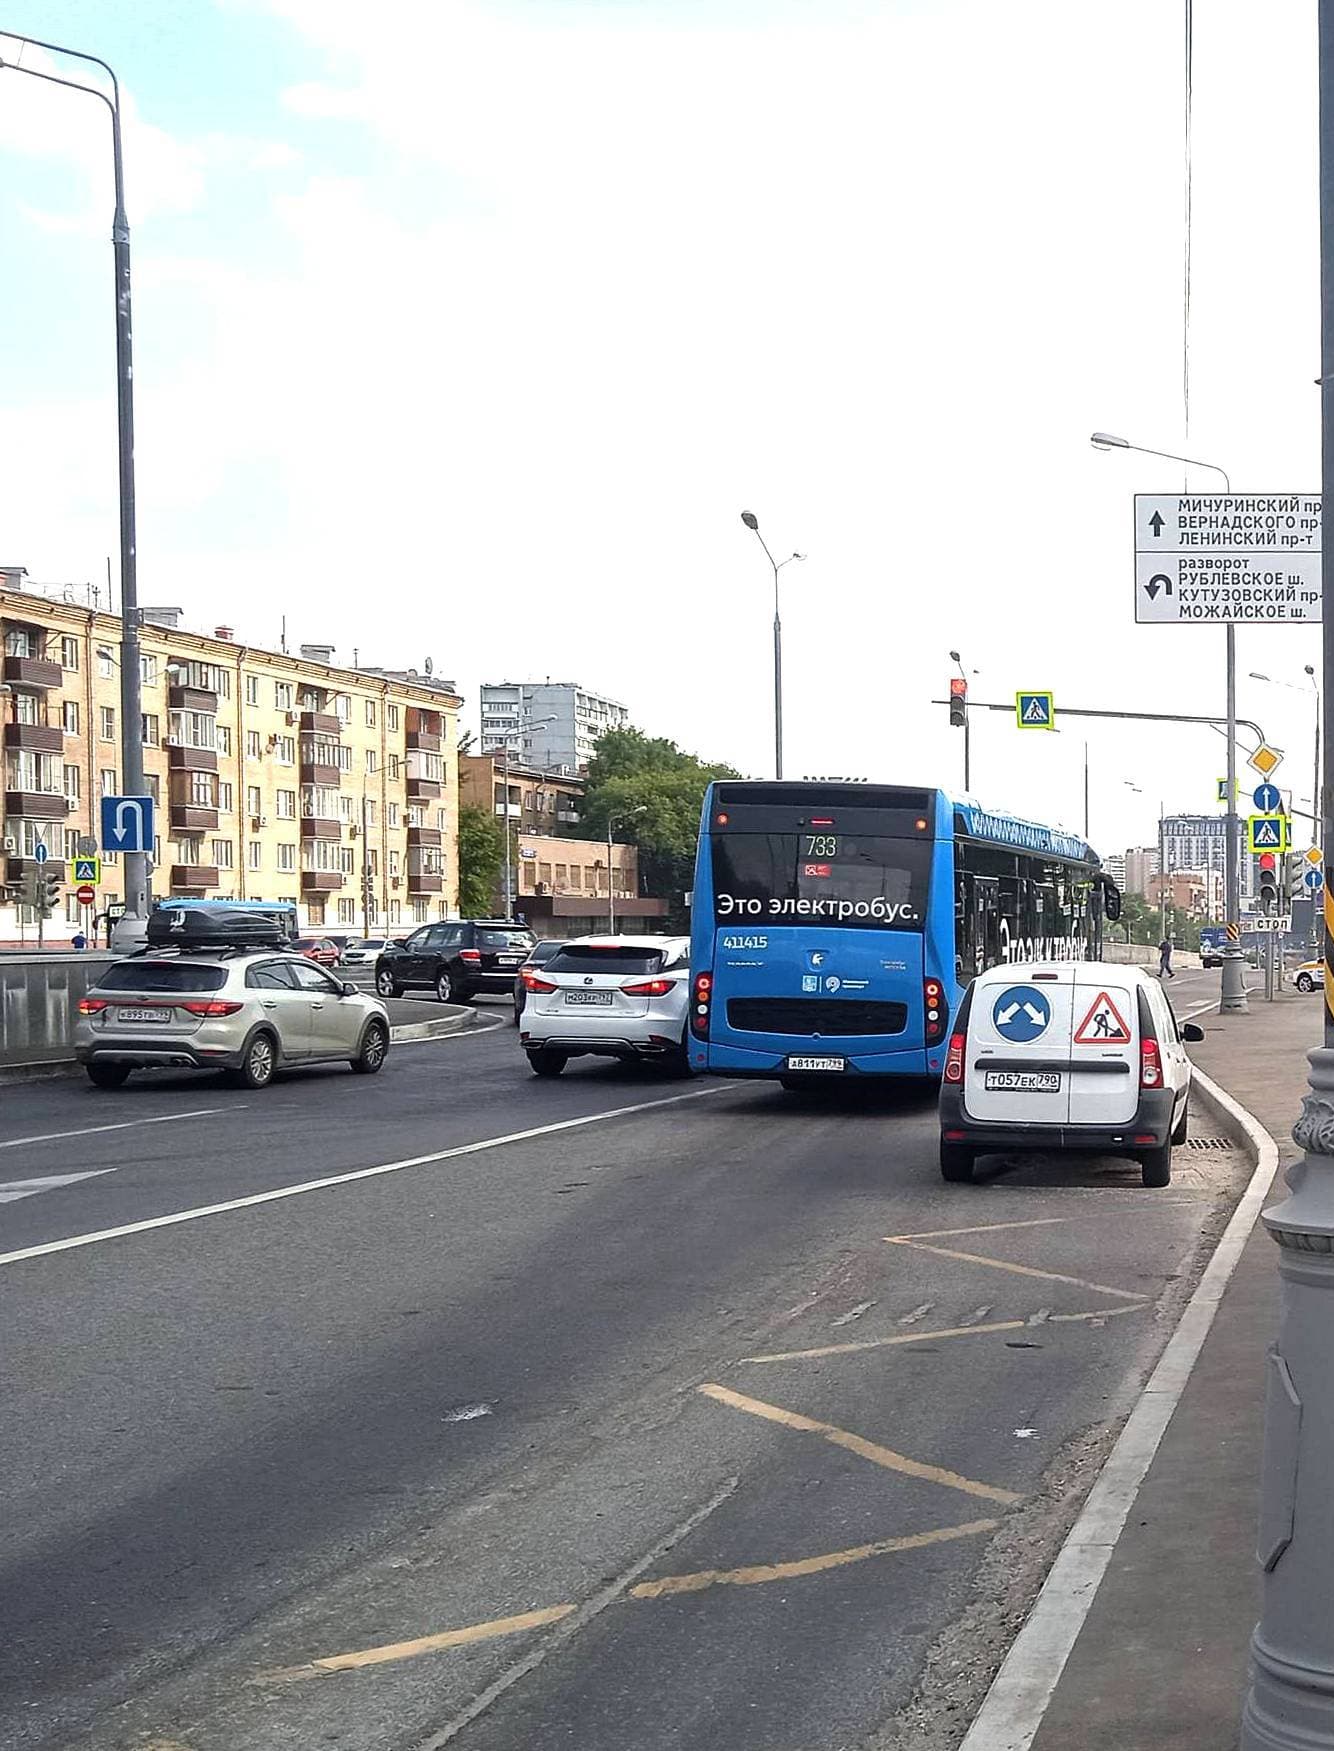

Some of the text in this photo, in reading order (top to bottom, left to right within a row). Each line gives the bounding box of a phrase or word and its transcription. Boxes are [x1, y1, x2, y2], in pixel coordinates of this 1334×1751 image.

[1178, 496, 1322, 515] МИЧУРИНСКИЙ пр
[1178, 515, 1296, 531] ВЕРНАДСКОГО
[1178, 529, 1314, 548] ЛЕНИНСКИЙ пр-т
[1178, 558, 1250, 572] разворот
[1178, 572, 1304, 585] РУБЛЕВСКОЕ ш.
[1178, 586, 1323, 604] КУТУЗОВСКИЙ пр-
[1179, 603, 1307, 618] МОЖАЙСКОЕ ш.
[806, 835, 836, 857] 733
[716, 893, 919, 923] Это электробус.
[1257, 919, 1288, 929] СТОП
[723, 936, 768, 949] 411415
